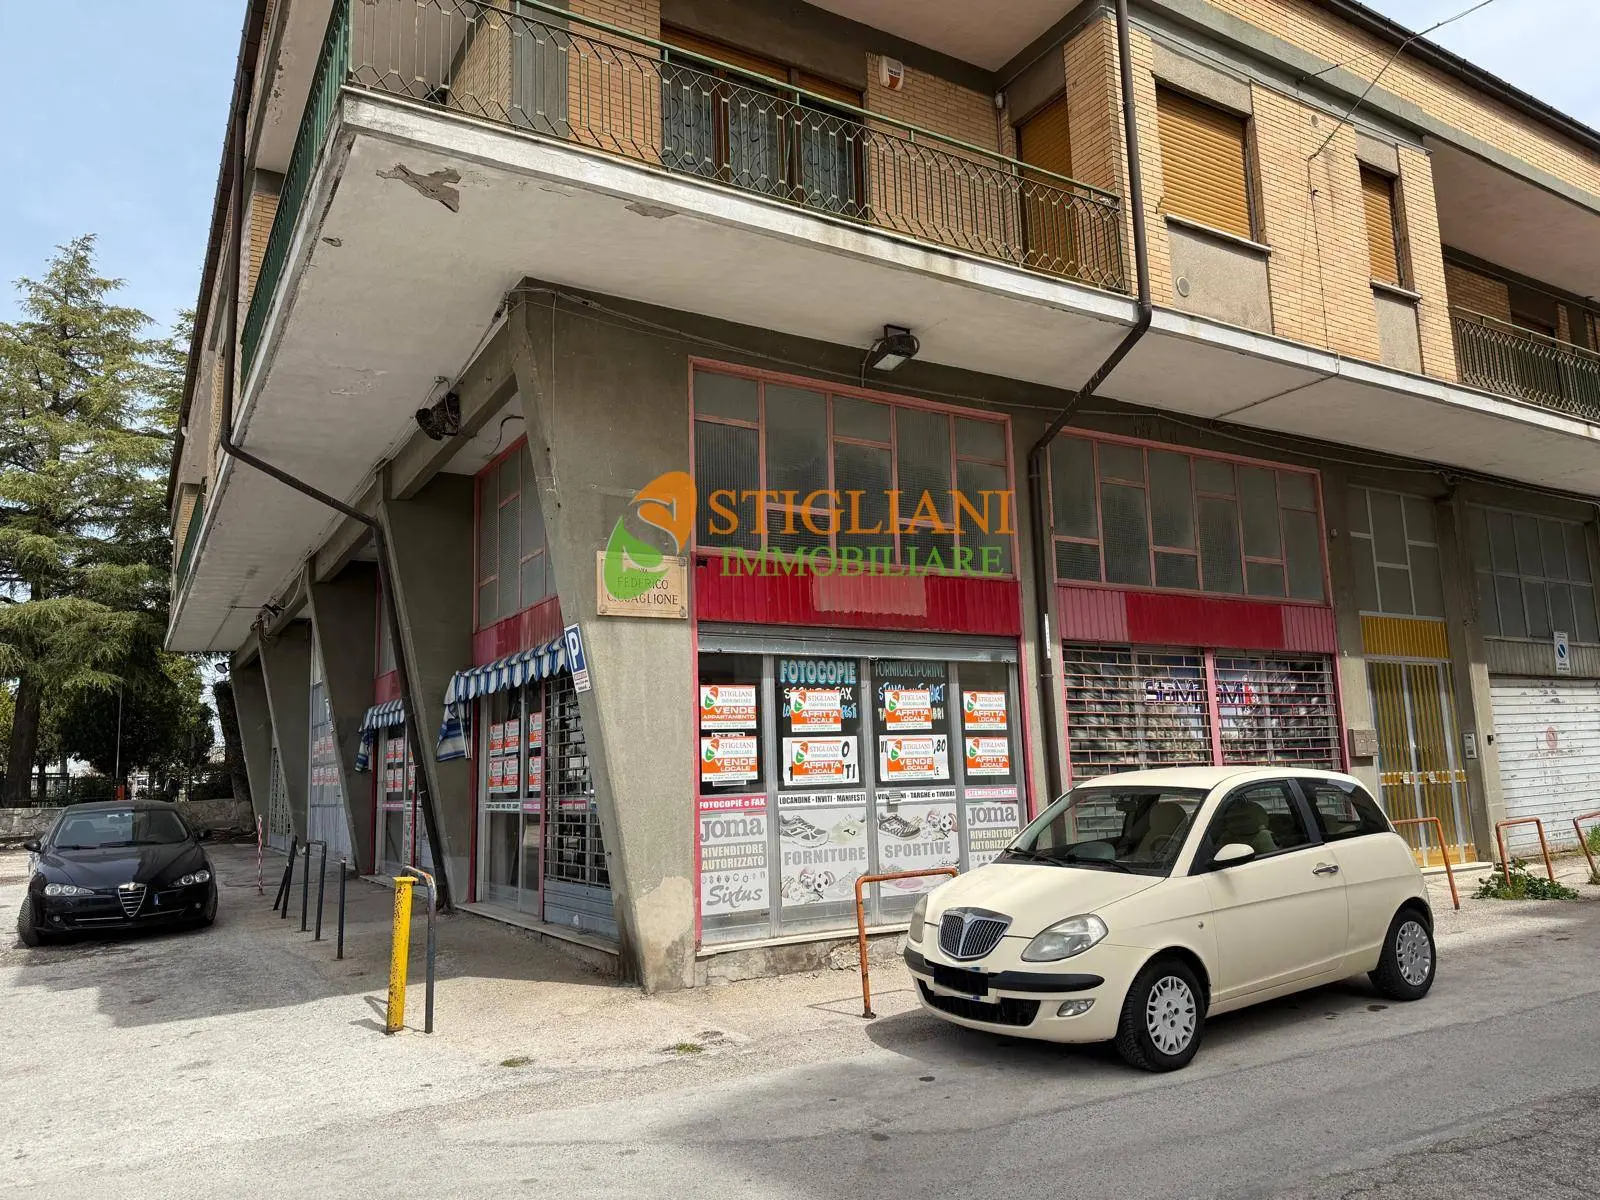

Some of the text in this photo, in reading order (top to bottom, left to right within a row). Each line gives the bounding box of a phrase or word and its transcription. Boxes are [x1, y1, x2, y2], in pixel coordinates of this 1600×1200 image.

[780, 660, 857, 684] FOTOCOPIE
[720, 690, 753, 698] STIGLIANI
[714, 706, 756, 714] VENDE
[896, 709, 930, 717] AFFITTA
[721, 742, 754, 750] STIGLIANI
[715, 758, 757, 766] VENDE
[803, 761, 841, 769] AFFITTA
[899, 758, 933, 766] VENDE
[721, 765, 751, 773] LOCALE
[779, 796, 811, 805] LOCANDINE
[816, 795, 832, 803] INVITI
[837, 793, 866, 802] MANIFESTI
[910, 791, 931, 799] TARGHE
[936, 790, 955, 798] TIMBRI
[700, 799, 742, 808] FOTOCOPIE
[752, 798, 765, 806] FAX
[970, 828, 1017, 840] RIVENDITORE
[702, 843, 764, 857] RIVENDITORE
[884, 841, 951, 859] SPORTIVE
[784, 847, 866, 866] FORNITURE
[701, 855, 765, 870] AUTORIZZATO
[706, 885, 763, 908] Sixtus
